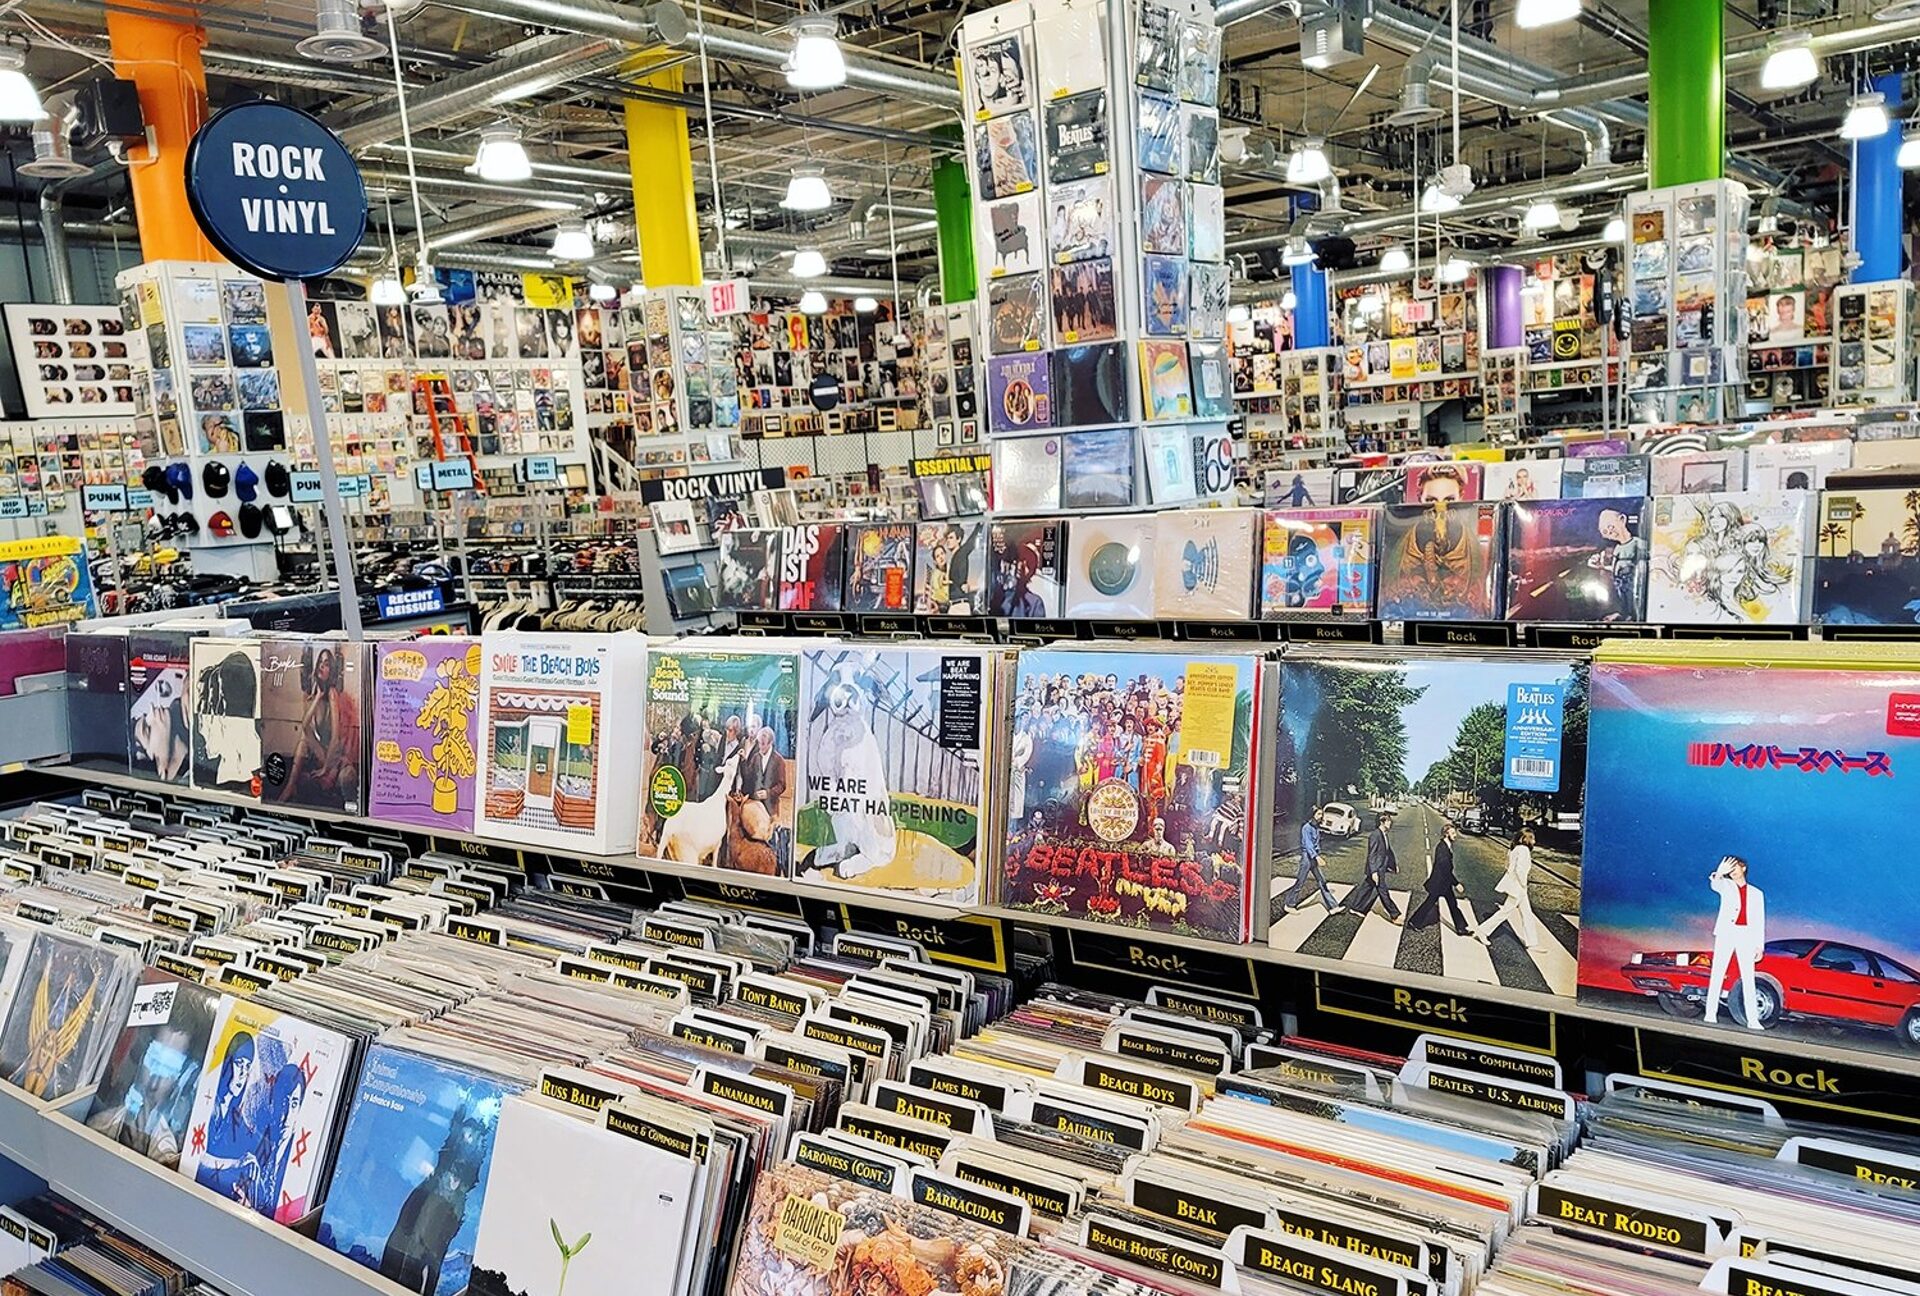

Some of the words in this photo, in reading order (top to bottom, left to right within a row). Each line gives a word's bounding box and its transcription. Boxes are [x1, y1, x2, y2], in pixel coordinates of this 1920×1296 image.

[233, 142, 326, 182] ROCK
[241, 197, 335, 236] VINYL
[711, 283, 737, 312] EXIT
[438, 468, 468, 477] METAL
[914, 457, 974, 476] ESSENTIAL
[974, 456, 991, 472] VIN
[88, 493, 122, 503] PUNK
[296, 480, 322, 492] PUN
[662, 477, 711, 500] ROCK
[714, 472, 767, 496] VINYL
[782, 525, 819, 555] DAS
[781, 554, 809, 582] IST
[386, 600, 442, 617] REISSUES
[388, 590, 434, 606] RECENT
[780, 581, 815, 610] DAF
[880, 621, 899, 630] Rock
[1210, 627, 1236, 638] Rock
[1317, 627, 1344, 638] Rock
[1447, 630, 1477, 645] Rock
[522, 655, 538, 673] THE
[540, 653, 572, 676] BEACH
[575, 656, 600, 677] BOYS
[655, 667, 685, 680] Beach
[660, 657, 680, 668] The
[650, 678, 673, 690] Boys
[672, 679, 689, 690] Pet
[653, 688, 690, 702] Sounds
[1517, 687, 1555, 707] BEATLES
[1710, 742, 1895, 778] ハイパースペース
[808, 775, 831, 792] WE
[835, 779, 867, 794] ARE
[819, 796, 862, 815] BEAT
[865, 800, 968, 826] HAPPENING
[343, 855, 366, 867] ARCADE
[367, 858, 380, 869] FIRE
[461, 841, 488, 857] Rock
[581, 860, 615, 878] Rock
[1025, 845, 1204, 897] BEATLES
[562, 884, 575, 894] AN
[581, 888, 593, 898] AZ
[719, 882, 757, 901] Rock
[314, 935, 322, 944] AS
[327, 937, 339, 948] LAY
[340, 940, 359, 953] DYING
[455, 925, 469, 938] AA
[475, 930, 492, 943] AM
[645, 925, 663, 940] BAD
[664, 929, 705, 949] COMPANY
[896, 920, 945, 946] Rock
[838, 942, 875, 958] COURTNEY
[1130, 946, 1189, 974] Rock
[231, 974, 260, 993] ARGENT
[657, 967, 681, 983] BABY
[681, 972, 706, 990] METAL
[741, 986, 768, 1009] TONY
[768, 994, 801, 1015] BANKS
[1166, 997, 1204, 1017] BEACH
[1207, 1006, 1246, 1025] HOUSE
[1394, 988, 1469, 1023] Rock
[682, 1028, 703, 1045] THE
[705, 1035, 734, 1053] BAND
[806, 1026, 845, 1047] DEVENDRA
[846, 1035, 883, 1055] BANHART
[1122, 1038, 1145, 1053] BEACH
[1146, 1043, 1165, 1056] BOYS
[1170, 1049, 1188, 1061] LIVE
[1195, 1053, 1220, 1068] COMPS
[787, 1057, 822, 1077] BANDIT
[1279, 1061, 1336, 1085] BEATLES
[1426, 1043, 1468, 1061] BEATLES
[1479, 1053, 1555, 1079] COMPILATIONS
[1099, 1072, 1139, 1096] BEACH
[1142, 1082, 1175, 1104] BOYS
[1740, 1056, 1840, 1094] Rock
[541, 1079, 569, 1100] RUSS
[571, 1087, 603, 1110] BALLA
[711, 1081, 776, 1113] BANANARAMA
[931, 1077, 958, 1096] JAMES
[960, 1084, 982, 1101] BAY
[1429, 1073, 1475, 1095] BEATLES
[1487, 1087, 1513, 1103] U.S.
[1517, 1093, 1565, 1116] ALBUMS
[896, 1096, 953, 1127] BATTLES
[608, 1114, 639, 1135] BALANCE
[639, 1125, 647, 1136] &
[648, 1128, 691, 1154] COMPOSURE
[847, 1124, 871, 1141] BAT
[873, 1130, 896, 1148] FOR
[900, 1135, 943, 1161] LASHES
[1057, 1116, 1115, 1145] BAUHAUS
[798, 1144, 849, 1172] BARONESS
[851, 1160, 893, 1186] (CONT.)
[1856, 1165, 1917, 1189] BECK
[924, 1184, 1005, 1225] BARRACUDAS
[959, 1169, 1008, 1194] JULIANNA
[1011, 1185, 1064, 1214] BARWICK
[782, 1198, 842, 1246] BARONESS
[1177, 1199, 1217, 1226] BEAK
[1560, 1199, 1608, 1226] BEAT
[1615, 1211, 1682, 1245] RODEO
[1091, 1228, 1127, 1251] BEACH
[1129, 1240, 1169, 1264] HOUSE
[1171, 1252, 1219, 1280] (CONT.)
[1321, 1229, 1340, 1248] IN
[1345, 1236, 1414, 1269] HEAVEN
[1260, 1247, 1316, 1287] BEACH
[1319, 1267, 1379, 1296] SLANG
